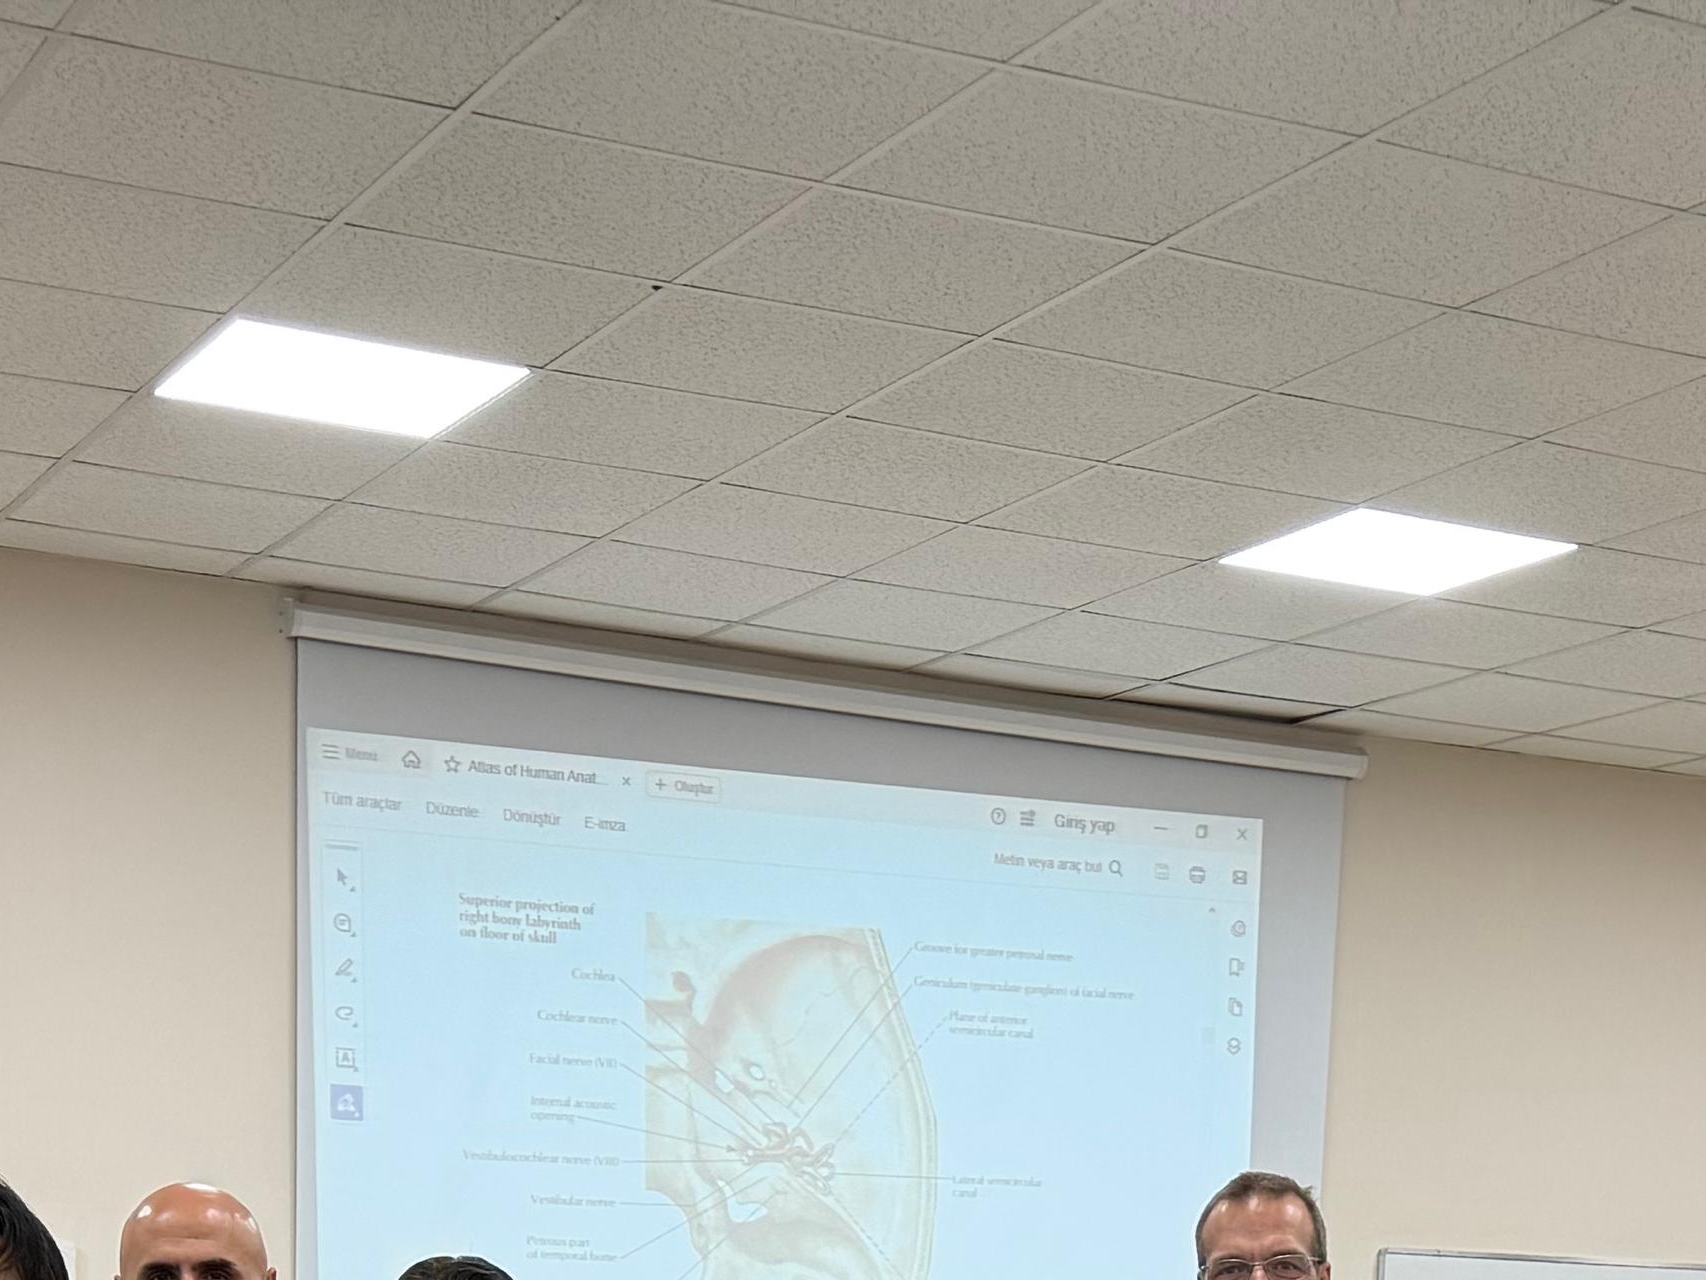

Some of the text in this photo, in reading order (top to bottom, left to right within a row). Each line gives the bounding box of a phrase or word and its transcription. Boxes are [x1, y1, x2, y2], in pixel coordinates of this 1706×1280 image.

[468, 759, 502, 776] Atlas
[505, 763, 518, 777] of
[520, 765, 564, 782] Human
[324, 790, 402, 813] Tüm araçlar
[426, 802, 480, 819] Düzenle
[1054, 813, 1116, 836] Giriş yap
[994, 852, 1024, 867] Metin
[1027, 857, 1054, 872] veya
[1057, 860, 1082, 875] araç
[459, 893, 595, 917] Superior projection of
[459, 910, 581, 932] right bony labyrinth
[459, 926, 557, 945] on floor of skull
[571, 968, 616, 983] Cochlea
[537, 1010, 585, 1024] Cochlear
[529, 1053, 560, 1066] Facial
[562, 1058, 592, 1068] nerve
